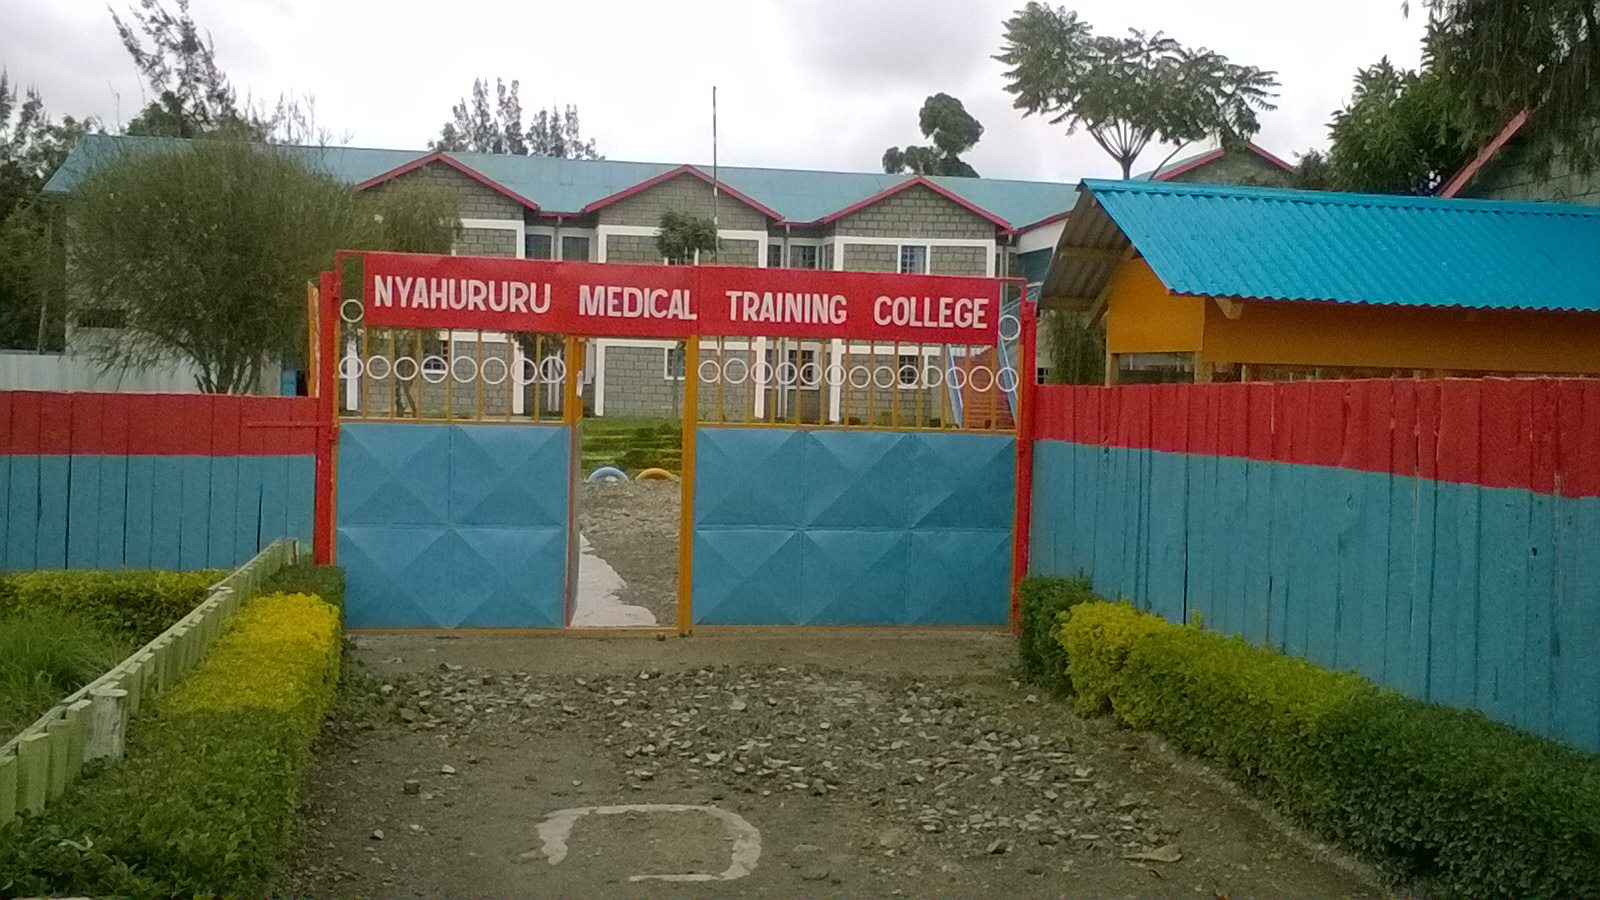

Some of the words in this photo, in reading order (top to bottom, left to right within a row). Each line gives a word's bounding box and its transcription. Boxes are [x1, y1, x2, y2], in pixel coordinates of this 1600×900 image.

[373, 274, 552, 315] NYAHURURU
[578, 285, 699, 322] MEDICAL
[725, 290, 848, 325] TRAINING
[874, 296, 990, 330] COLLEGE
